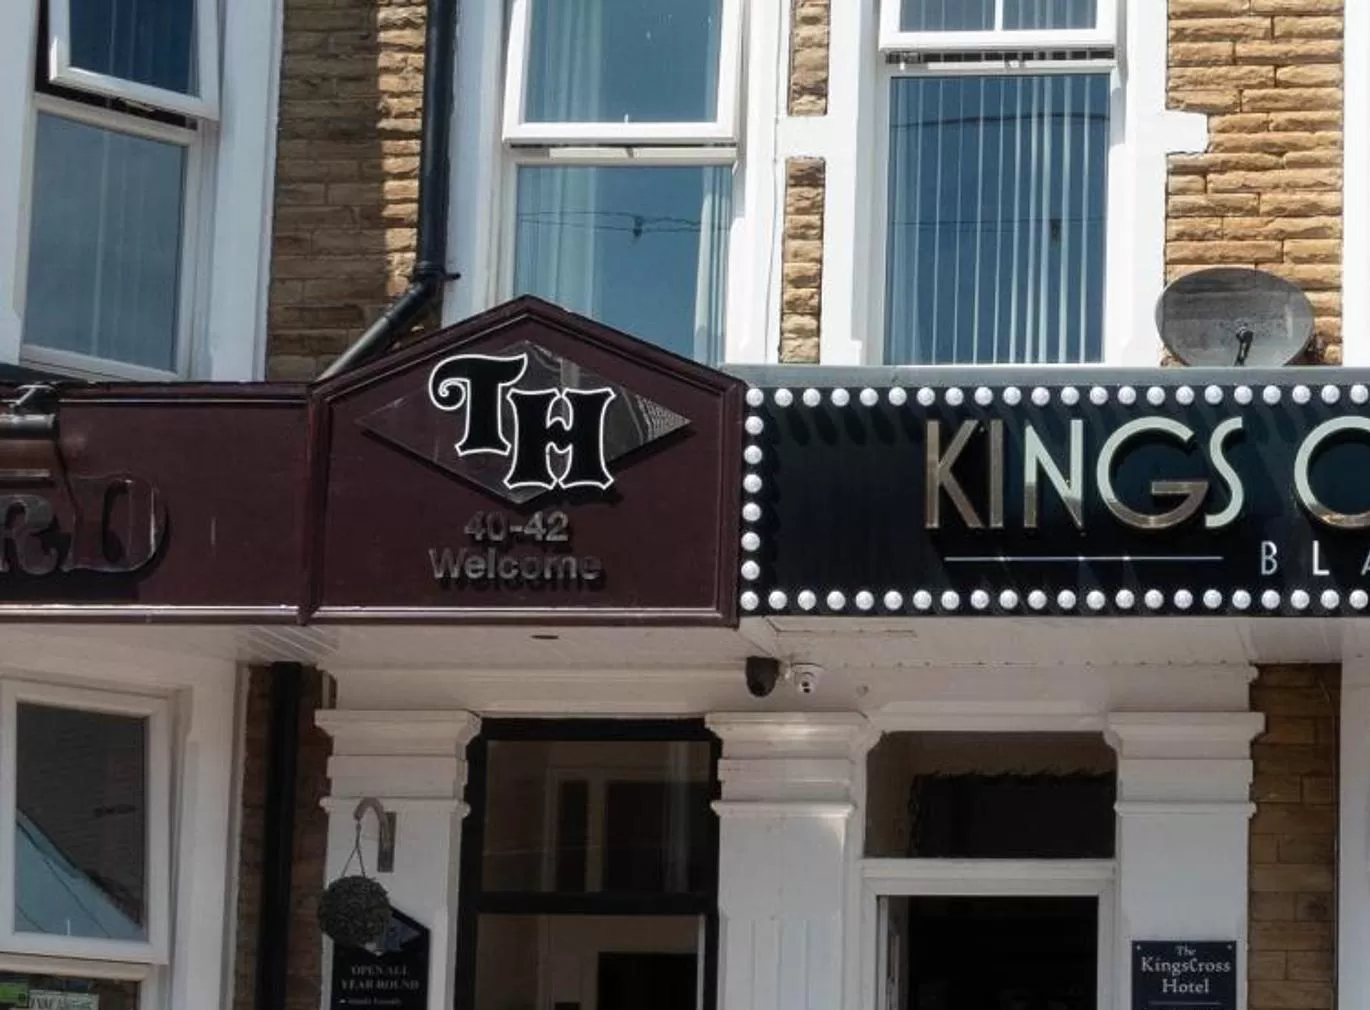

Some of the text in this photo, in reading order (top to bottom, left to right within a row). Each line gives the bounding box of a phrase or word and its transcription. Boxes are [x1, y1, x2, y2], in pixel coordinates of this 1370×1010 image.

[925, 416, 1244, 529] KINGS
[464, 511, 569, 542] 40-42
[428, 547, 600, 580] Welcome
[1175, 944, 1196, 957] The
[1162, 978, 1210, 994] Hotel
